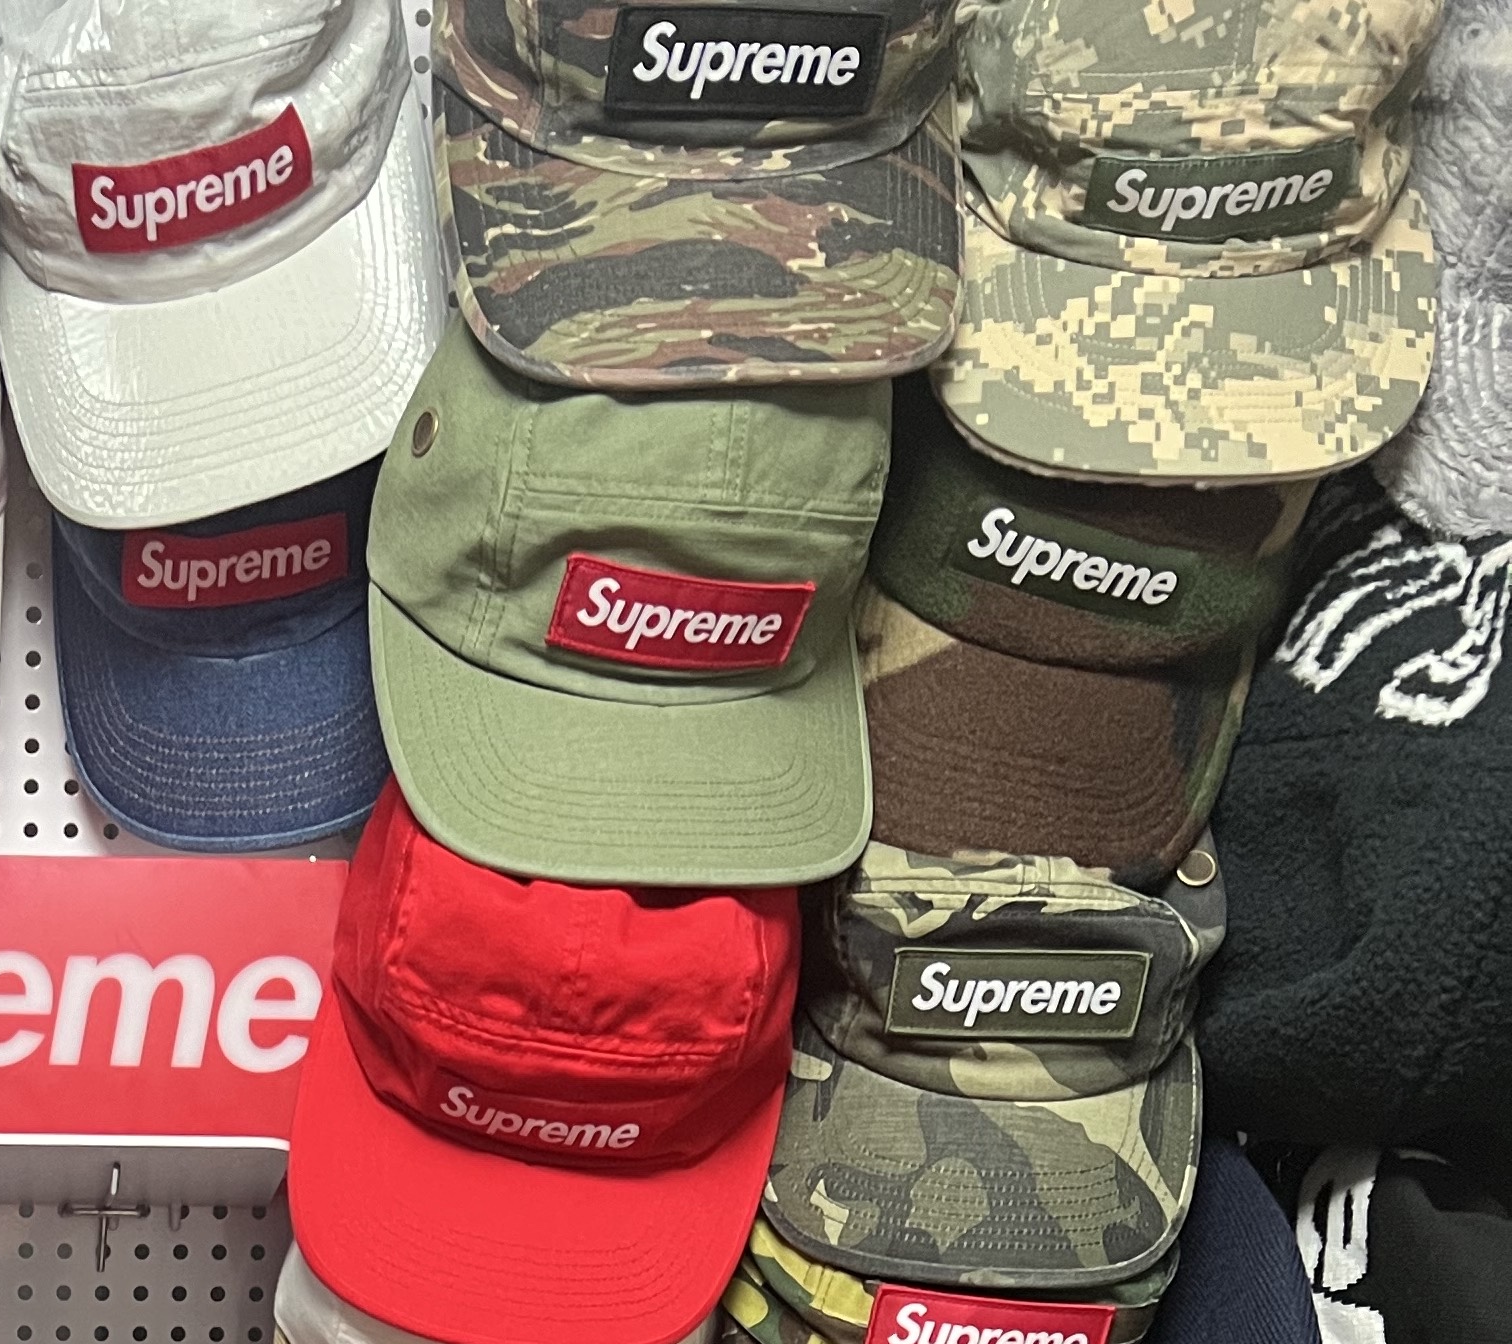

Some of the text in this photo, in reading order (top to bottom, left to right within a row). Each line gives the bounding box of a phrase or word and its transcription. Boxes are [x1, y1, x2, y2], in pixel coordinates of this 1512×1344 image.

[633, 20, 861, 100] Supreme
[91, 144, 294, 242] Supreme
[1107, 162, 1334, 231] Supreme
[137, 538, 332, 600] Supreme
[967, 507, 1179, 607] Supreme
[576, 577, 783, 650] Supreme
[911, 961, 1122, 1026] Supreme
[440, 1085, 640, 1150] Supreme
